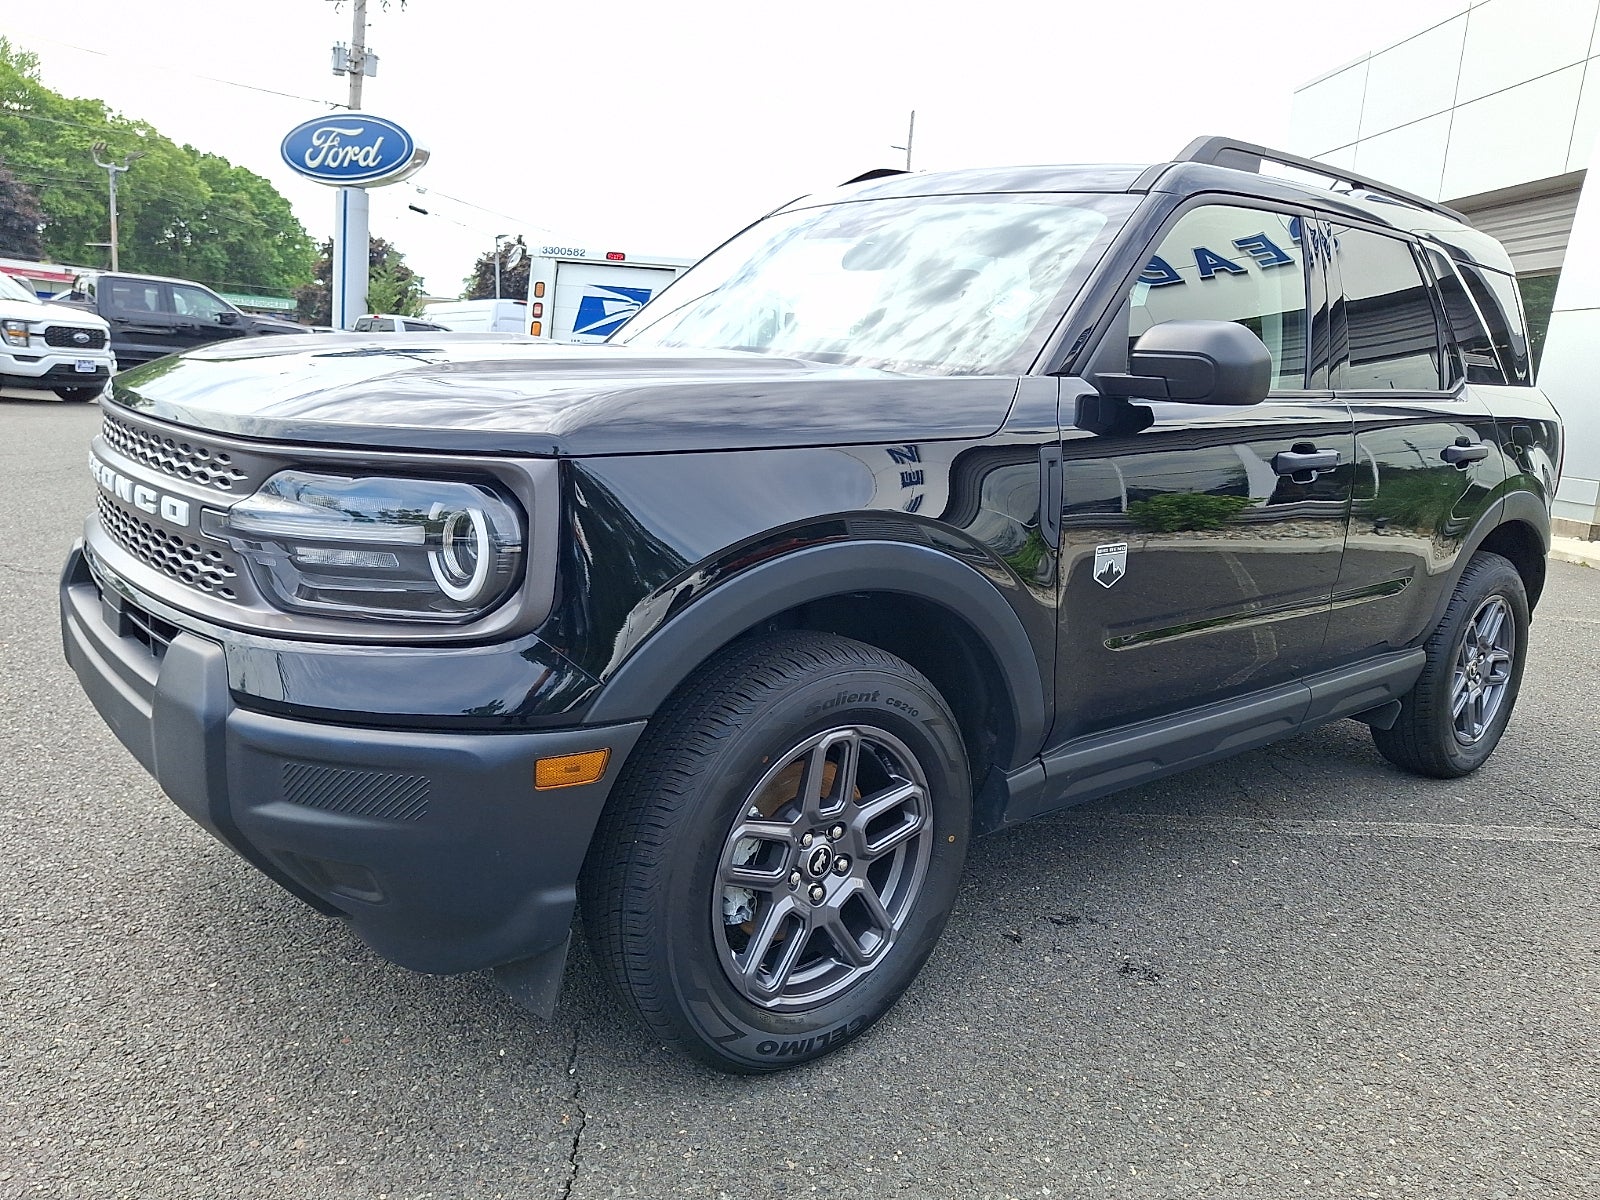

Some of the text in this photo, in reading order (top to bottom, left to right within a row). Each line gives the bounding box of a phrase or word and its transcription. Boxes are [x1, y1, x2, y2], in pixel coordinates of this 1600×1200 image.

[305, 127, 384, 168] Ford
[542, 246, 586, 257] 3300582
[804, 689, 919, 718] Salient CS210
